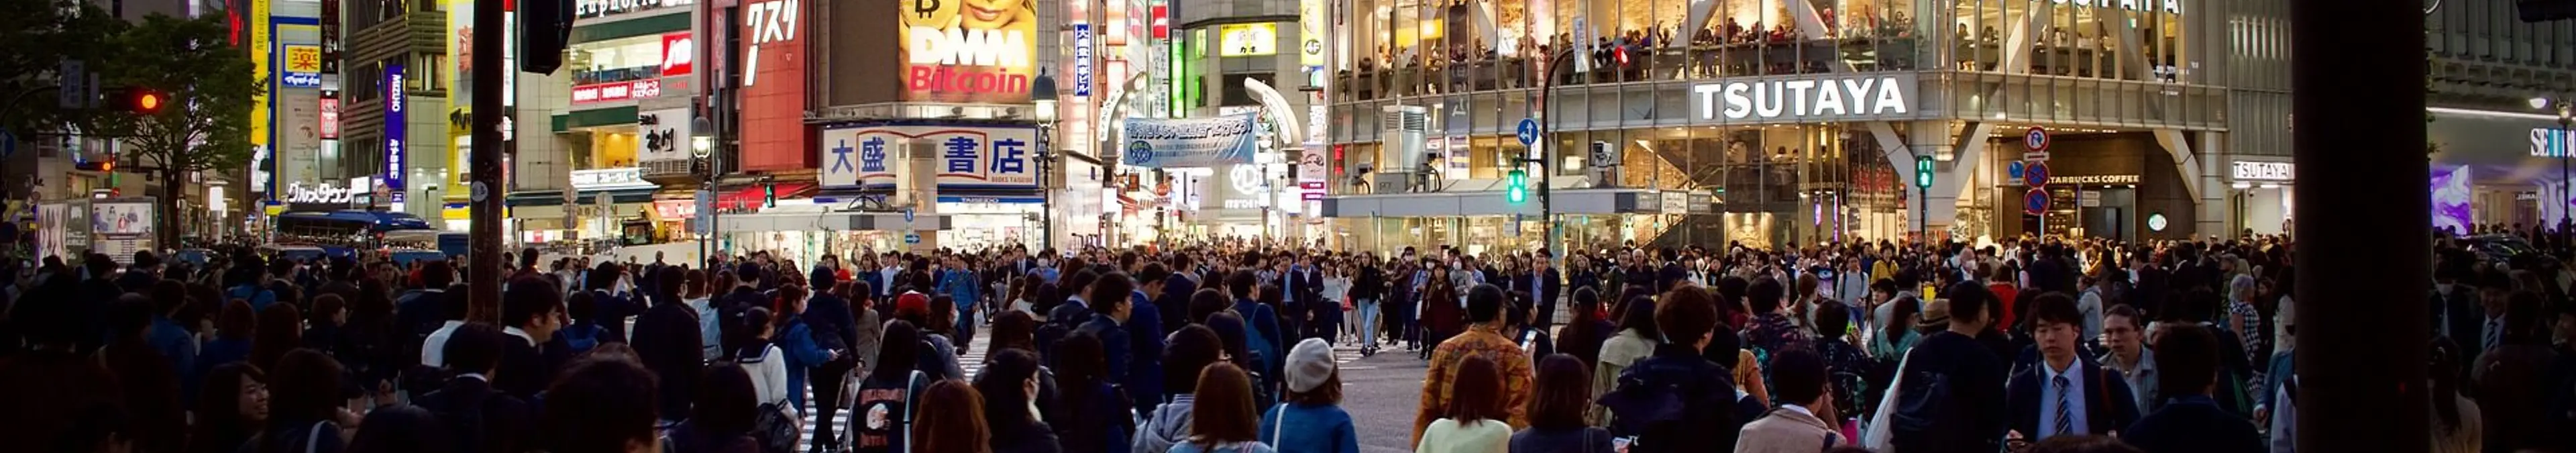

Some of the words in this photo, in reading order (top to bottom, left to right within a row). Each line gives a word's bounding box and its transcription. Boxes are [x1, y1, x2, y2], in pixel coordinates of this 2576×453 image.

[292, 48, 319, 70] 薬
[910, 25, 1028, 66] DMM
[909, 66, 1028, 93] Bitcoin
[1695, 77, 1907, 119] TSUTAYA
[830, 136, 1026, 174] 大盛書店
[2047, 175, 2100, 184] TARBUCKS
[2102, 175, 2140, 183] COFFEE
[2233, 163, 2288, 177] TSUTAYA
